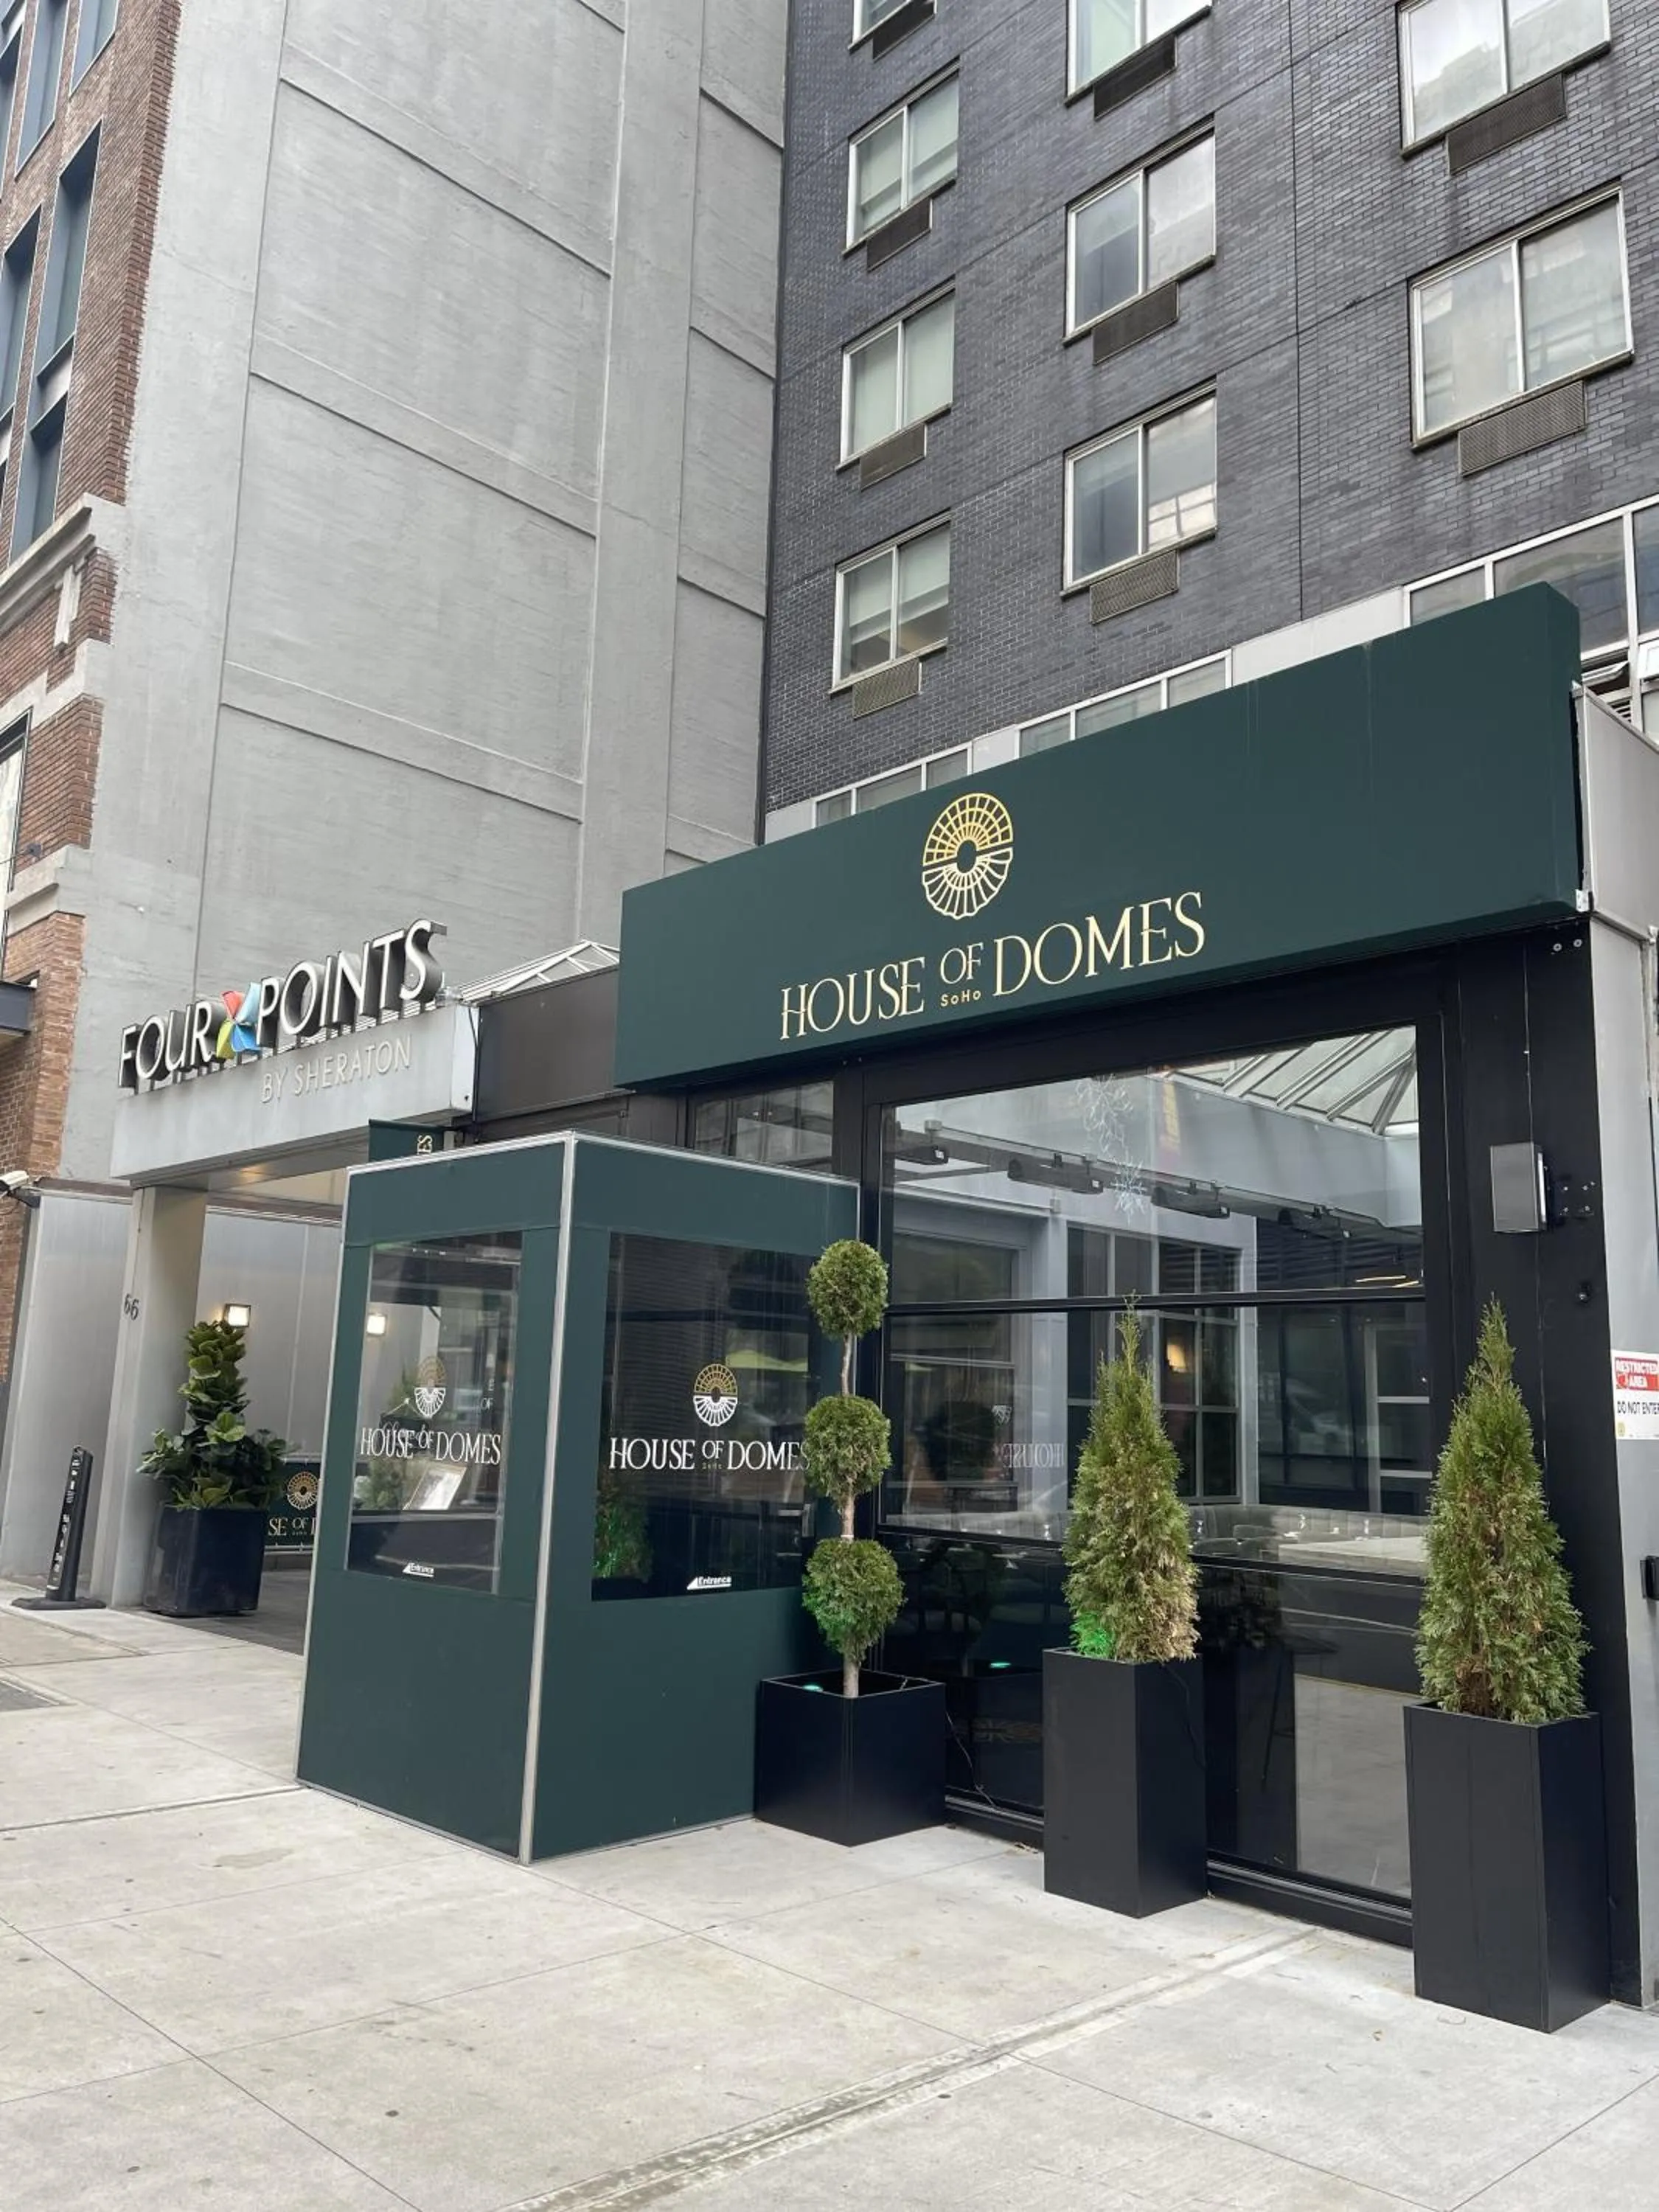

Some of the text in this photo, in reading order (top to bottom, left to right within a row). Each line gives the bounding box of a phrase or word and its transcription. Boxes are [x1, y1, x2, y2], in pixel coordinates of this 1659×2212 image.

[780, 891, 1206, 1040] HOUSE OF DOMES
[118, 919, 445, 1088] FOUR POINTS
[940, 989, 982, 1006] SoHo
[261, 1035, 412, 1103] BY SHERATON
[124, 1293, 139, 1321] 66
[1617, 1401, 1627, 1414] DO
[1627, 1402, 1641, 1415] NOT
[361, 1427, 414, 1458] HOUSE
[418, 1430, 434, 1450] OF
[436, 1431, 501, 1465] DOMES
[609, 1437, 810, 1471] HOUSE OF DOMES
[698, 1576, 731, 1585] Entrance
